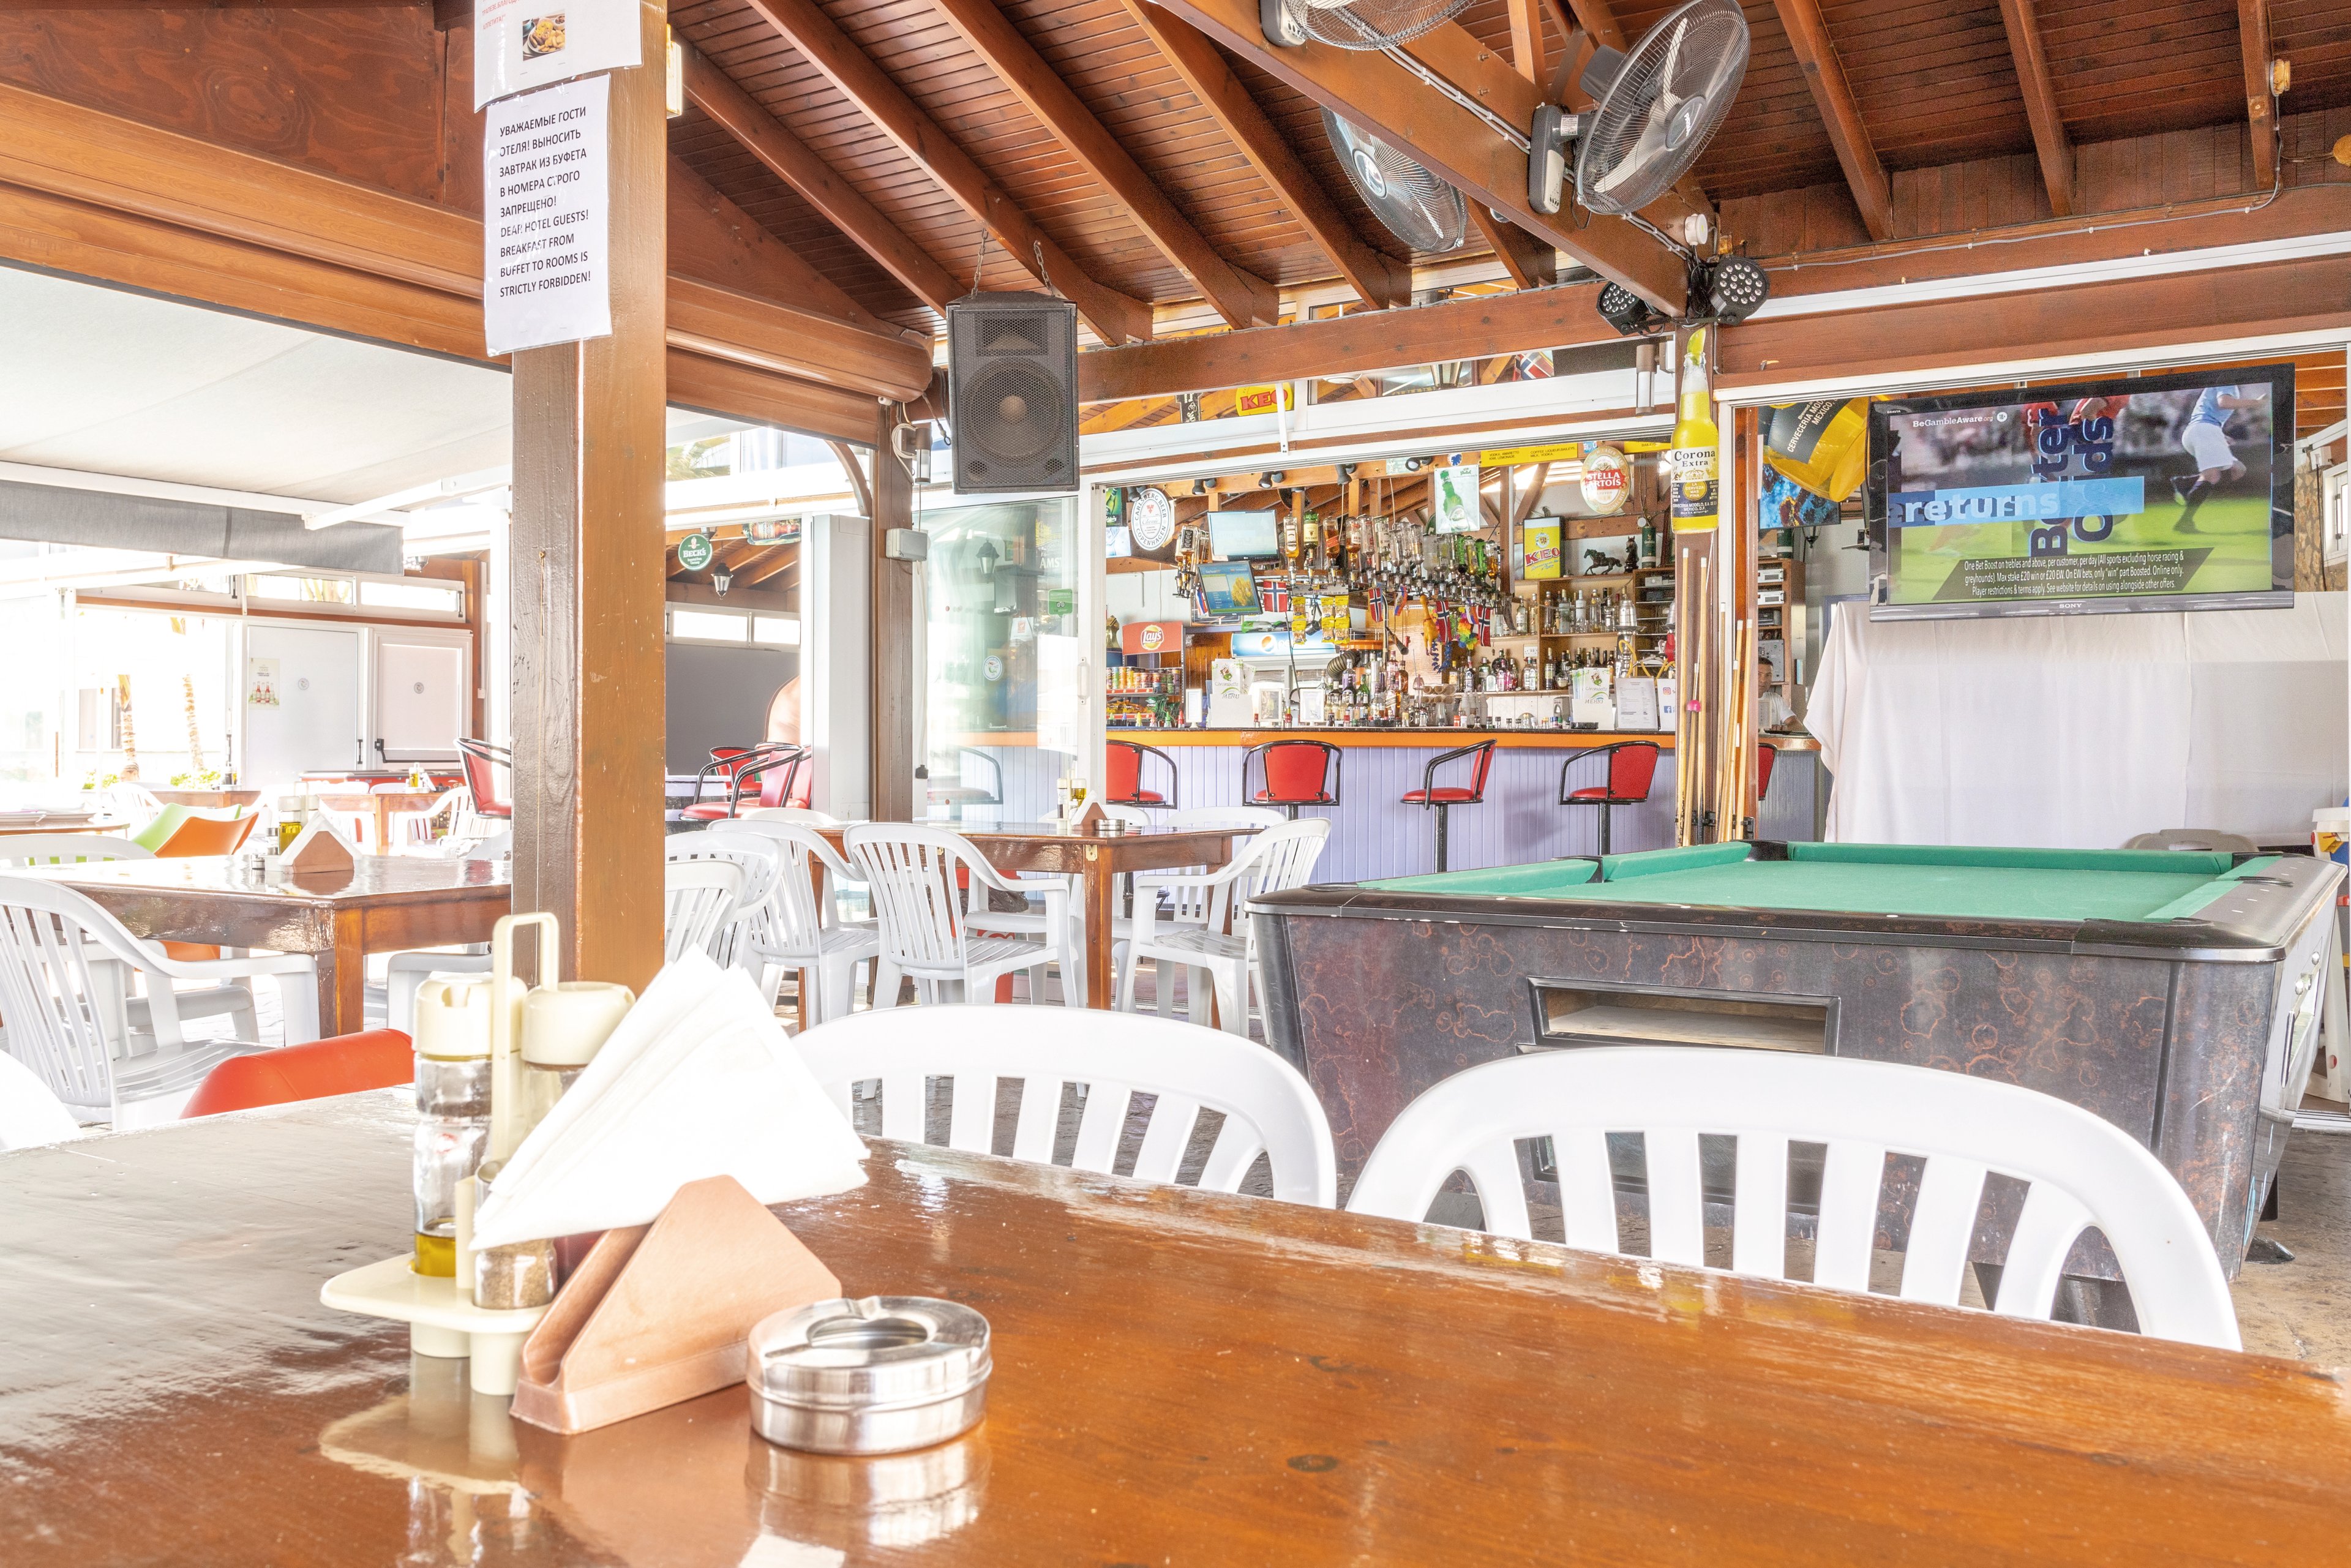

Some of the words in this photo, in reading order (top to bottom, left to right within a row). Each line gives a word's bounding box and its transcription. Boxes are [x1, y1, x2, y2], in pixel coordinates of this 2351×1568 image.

[500, 114, 556, 137] УВАЖАЕМЫЕ
[558, 107, 586, 122] ГОСТИ
[500, 140, 530, 157] ОТЕЛЯ!
[533, 129, 581, 149] ВЫНОСИТЬ
[500, 159, 537, 177] ЗАВТРАК
[539, 157, 550, 168] ИЗ
[553, 148, 587, 165] БУФЕТА
[500, 187, 505, 197] В
[508, 179, 545, 196] НОМЕРА
[500, 195, 557, 217] ЗАПРЕЩЕНО!
[525, 218, 551, 233] HOTEL
[553, 209, 588, 226] GUESTS!
[501, 239, 547, 257] BREAKFAST
[549, 233, 574, 247] FROM
[500, 263, 530, 277] BUFFET
[532, 260, 544, 271] TO
[546, 253, 578, 269] ROOMS
[581, 251, 588, 261] IS
[500, 282, 536, 297] STRICTLY
[539, 271, 591, 290] FORBIDDEN!
[1798, 404, 1811, 420] Brewed
[1787, 413, 1813, 452] CERVECERIA
[1809, 399, 1826, 414] MOD
[1674, 450, 1715, 461] Corona
[1588, 471, 1621, 481] STELLA
[1135, 493, 1159, 520] CARLSBERG
[1905, 492, 2059, 522] returns
[1136, 525, 1166, 546] COPENHAGEN
[1524, 547, 1561, 567] KEO
[1964, 560, 1974, 571] One
[1975, 560, 1984, 570] Bet
[1984, 560, 1998, 570] Boost
[2005, 558, 2021, 569] trebles
[2022, 558, 2031, 568] and
[2088, 555, 2097, 567] day
[2107, 554, 2121, 566] sports
[2122, 553, 2147, 565] excluding
[2147, 552, 2161, 562] horse
[2162, 552, 2179, 563] racing
[2180, 550, 2184, 560] &
[1997, 572, 2007, 582] Max
[2008, 571, 2020, 582] stake
[2020, 571, 2030, 581] £20
[2031, 571, 2039, 580] win
[2045, 570, 2056, 580] £20
[2065, 569, 2073, 579] On
[2074, 569, 2082, 579] EW
[2094, 568, 2104, 580] only
[2120, 567, 2129, 579] part
[2130, 565, 2152, 576] Boosted.
[2153, 564, 2170, 576] Online
[2171, 564, 2184, 577] only.
[1972, 586, 1987, 598] Player
[1988, 585, 2013, 595] restrictions
[2014, 585, 2017, 594] &
[2018, 585, 2031, 594] terms
[2032, 583, 2045, 596] apply.
[2046, 583, 2055, 593] See
[2056, 582, 2074, 592] website
[2082, 581, 2098, 591] details
[2105, 580, 2120, 593] using
[2120, 579, 2145, 592] alongside
[2145, 579, 2159, 588] other
[2159, 577, 2176, 588] offers.
[1143, 630, 1162, 643] Lay's
